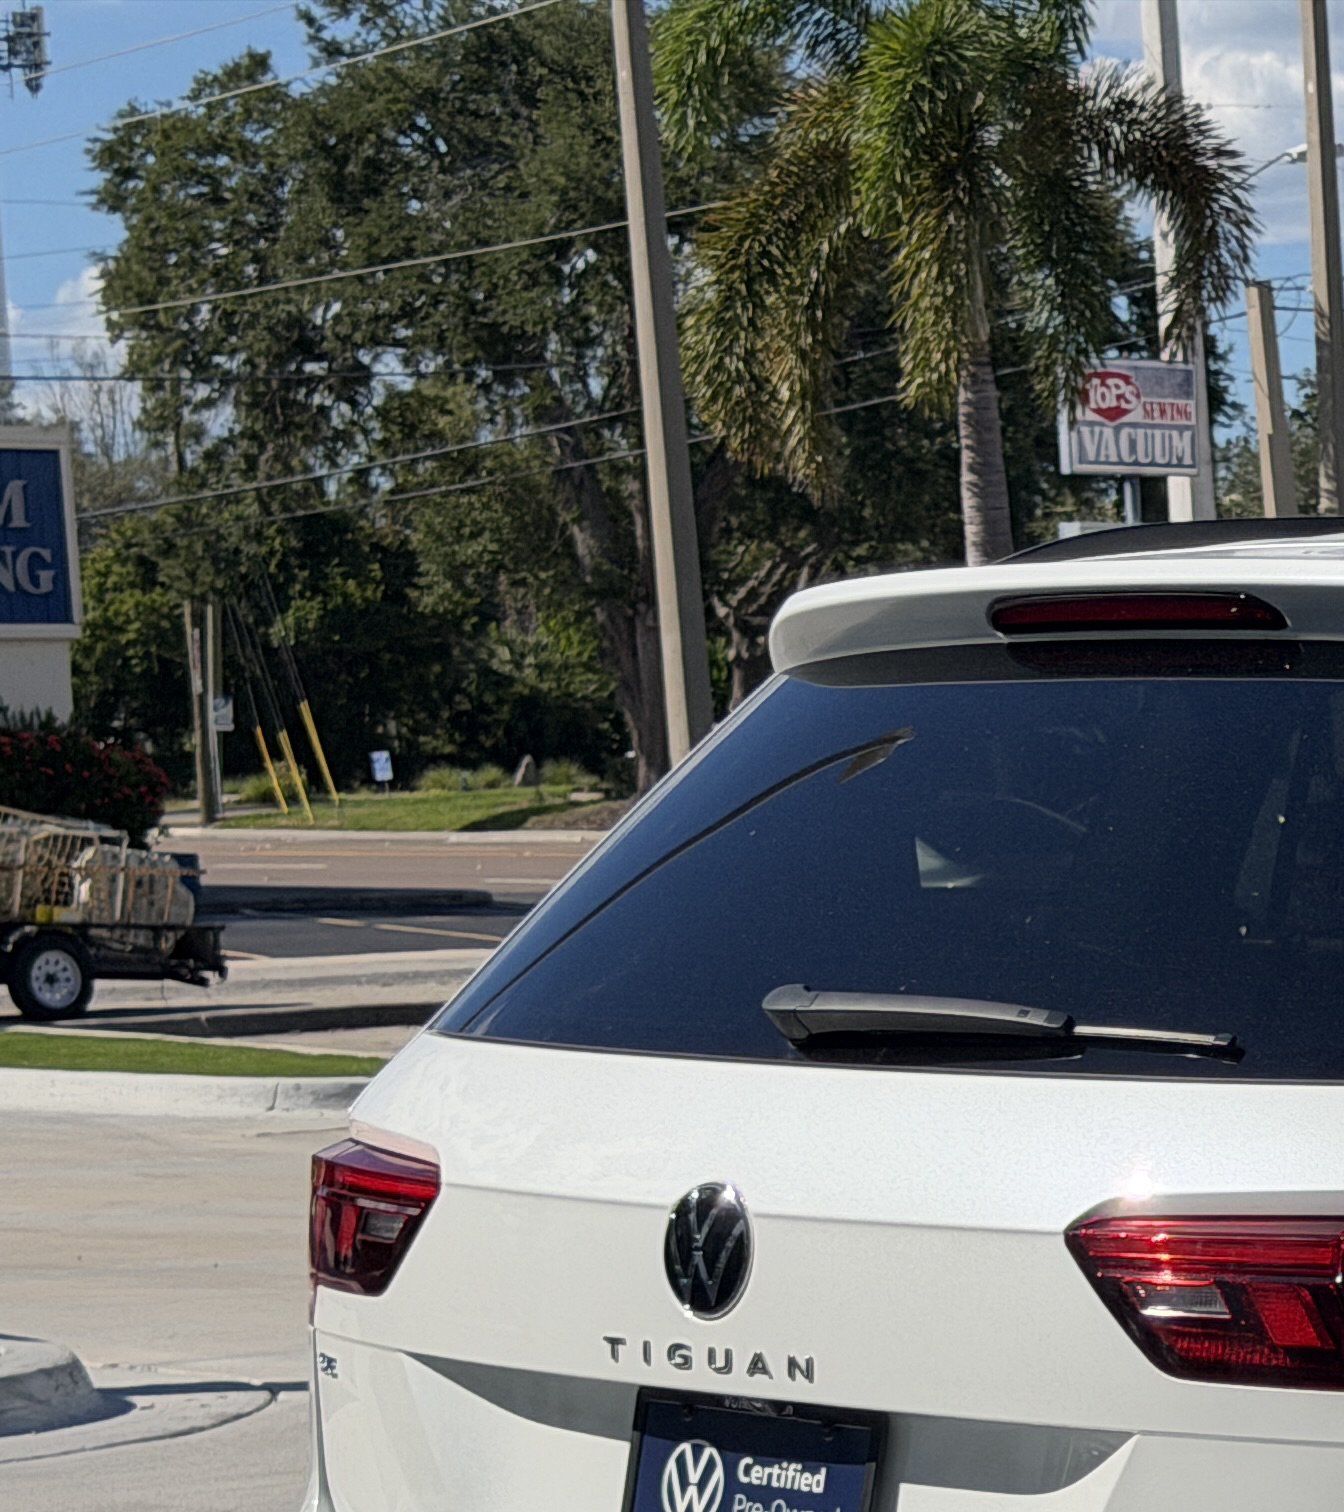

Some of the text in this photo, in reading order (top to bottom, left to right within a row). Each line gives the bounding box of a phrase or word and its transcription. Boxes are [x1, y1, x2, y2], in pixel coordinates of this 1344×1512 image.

[1142, 402, 1192, 422] SEWING
[1080, 426, 1193, 465] VACUUM
[603, 1336, 816, 1384] TIGUAN
[738, 1457, 826, 1493] Certified
